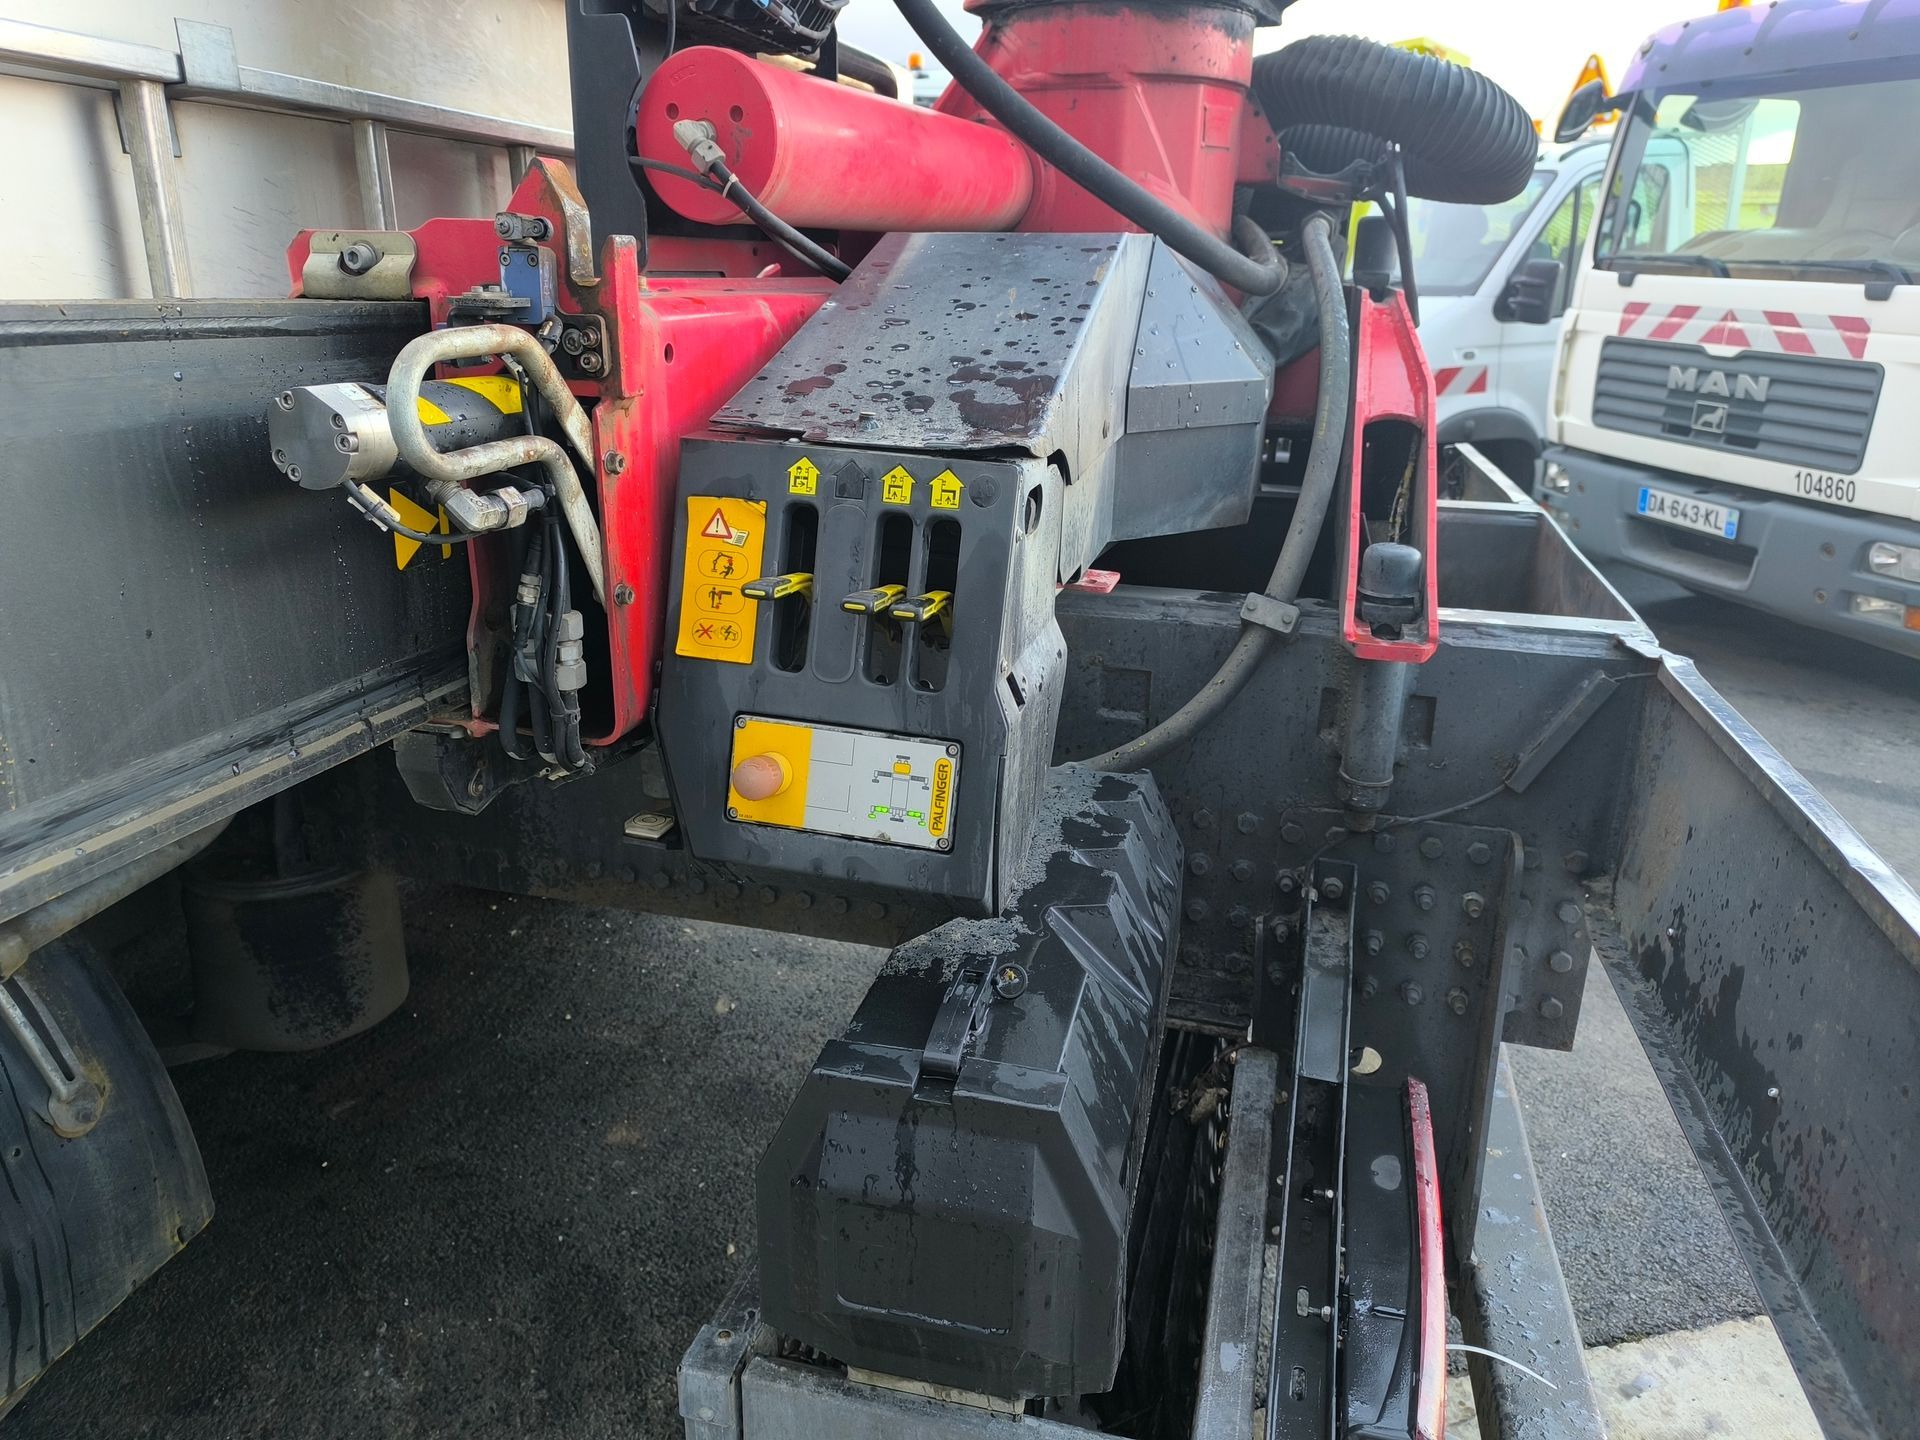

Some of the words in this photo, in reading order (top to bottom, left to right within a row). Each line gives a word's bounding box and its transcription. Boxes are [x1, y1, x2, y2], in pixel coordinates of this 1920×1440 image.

[1667, 365, 1770, 402] MAN
[1795, 470, 1856, 503] 104860
[1648, 493, 1723, 531] DA-643-KL
[932, 763, 949, 831] PALFINGER
